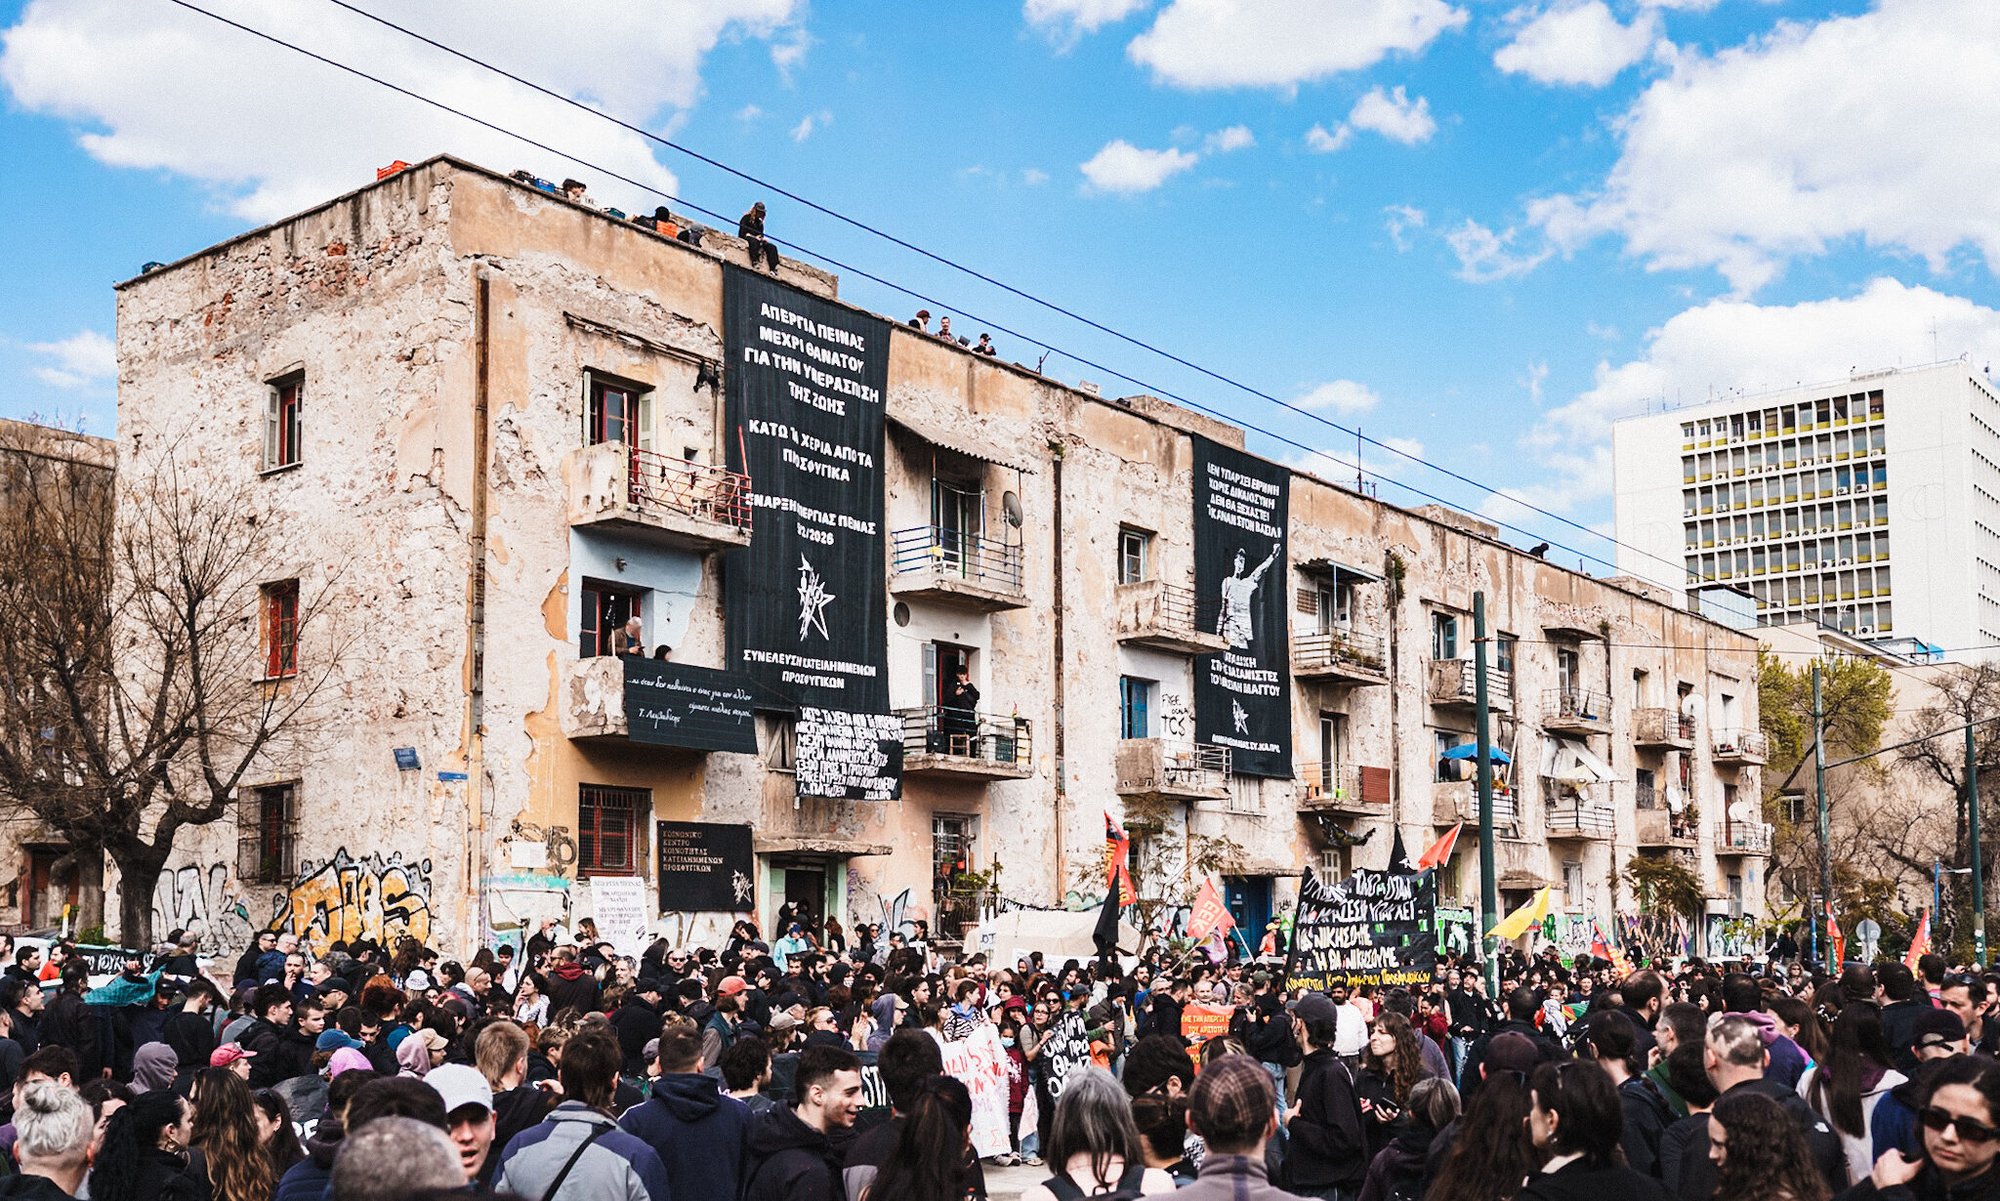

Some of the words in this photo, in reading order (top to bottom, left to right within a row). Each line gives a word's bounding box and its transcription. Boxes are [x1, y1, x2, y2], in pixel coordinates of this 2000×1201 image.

[760, 302, 817, 336] ΑΠΕΡΓΙΑ
[817, 323, 865, 352] ΠΕΙΝΑΣ
[744, 346, 771, 367] ΓΙΑ
[771, 352, 801, 376] ΤΗΝ
[759, 325, 805, 353] ΜΕΧΡΙ
[805, 342, 864, 374] ΘΑΝΑΤΟΥ
[788, 380, 811, 404] ΤΗΣ
[812, 391, 846, 417] ΖΩΗΣ
[749, 419, 789, 439] ΚΑΤΩ
[800, 433, 833, 457] ΧΕΡΙΑ
[833, 444, 857, 463] ΑΠΟ
[857, 451, 873, 469] ΤΑ
[1210, 493, 1225, 508] ΔΕΝ
[1225, 498, 1236, 512] ΘΑ
[743, 649, 802, 668] ΣΥΝΕΛΕΥΣΗ
[782, 670, 845, 689] ΠΡΟΣΦΥΓΙΚΩΝ
